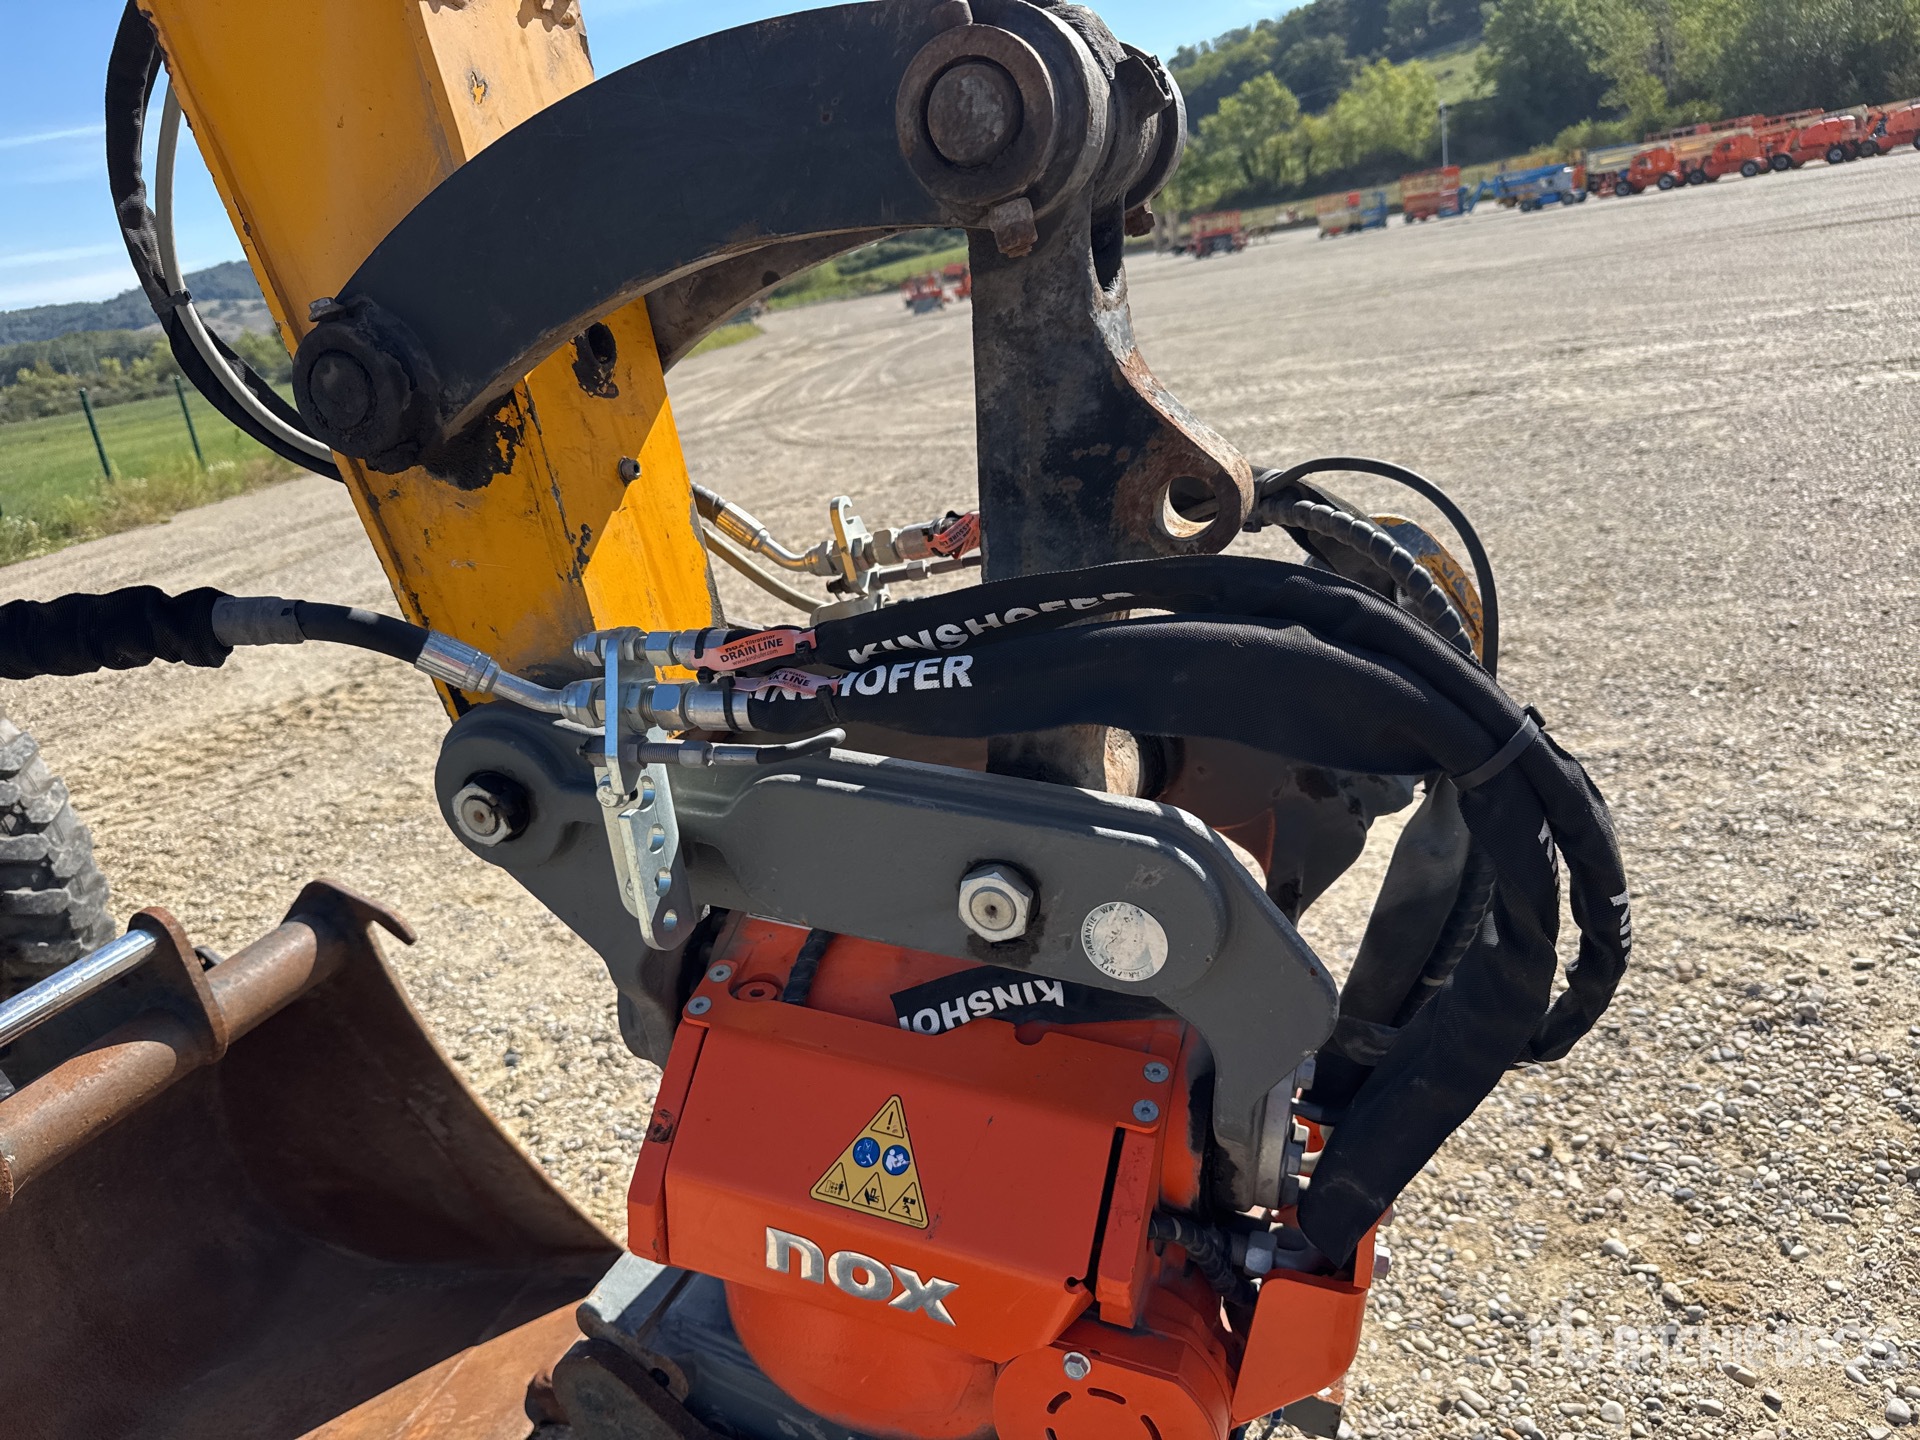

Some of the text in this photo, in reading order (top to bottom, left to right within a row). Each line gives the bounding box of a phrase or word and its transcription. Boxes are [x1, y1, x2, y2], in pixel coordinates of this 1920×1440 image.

[720, 638, 784, 663] DRAIN LINE
[783, 673, 811, 687] LINE
[766, 1226, 960, 1327] nox
